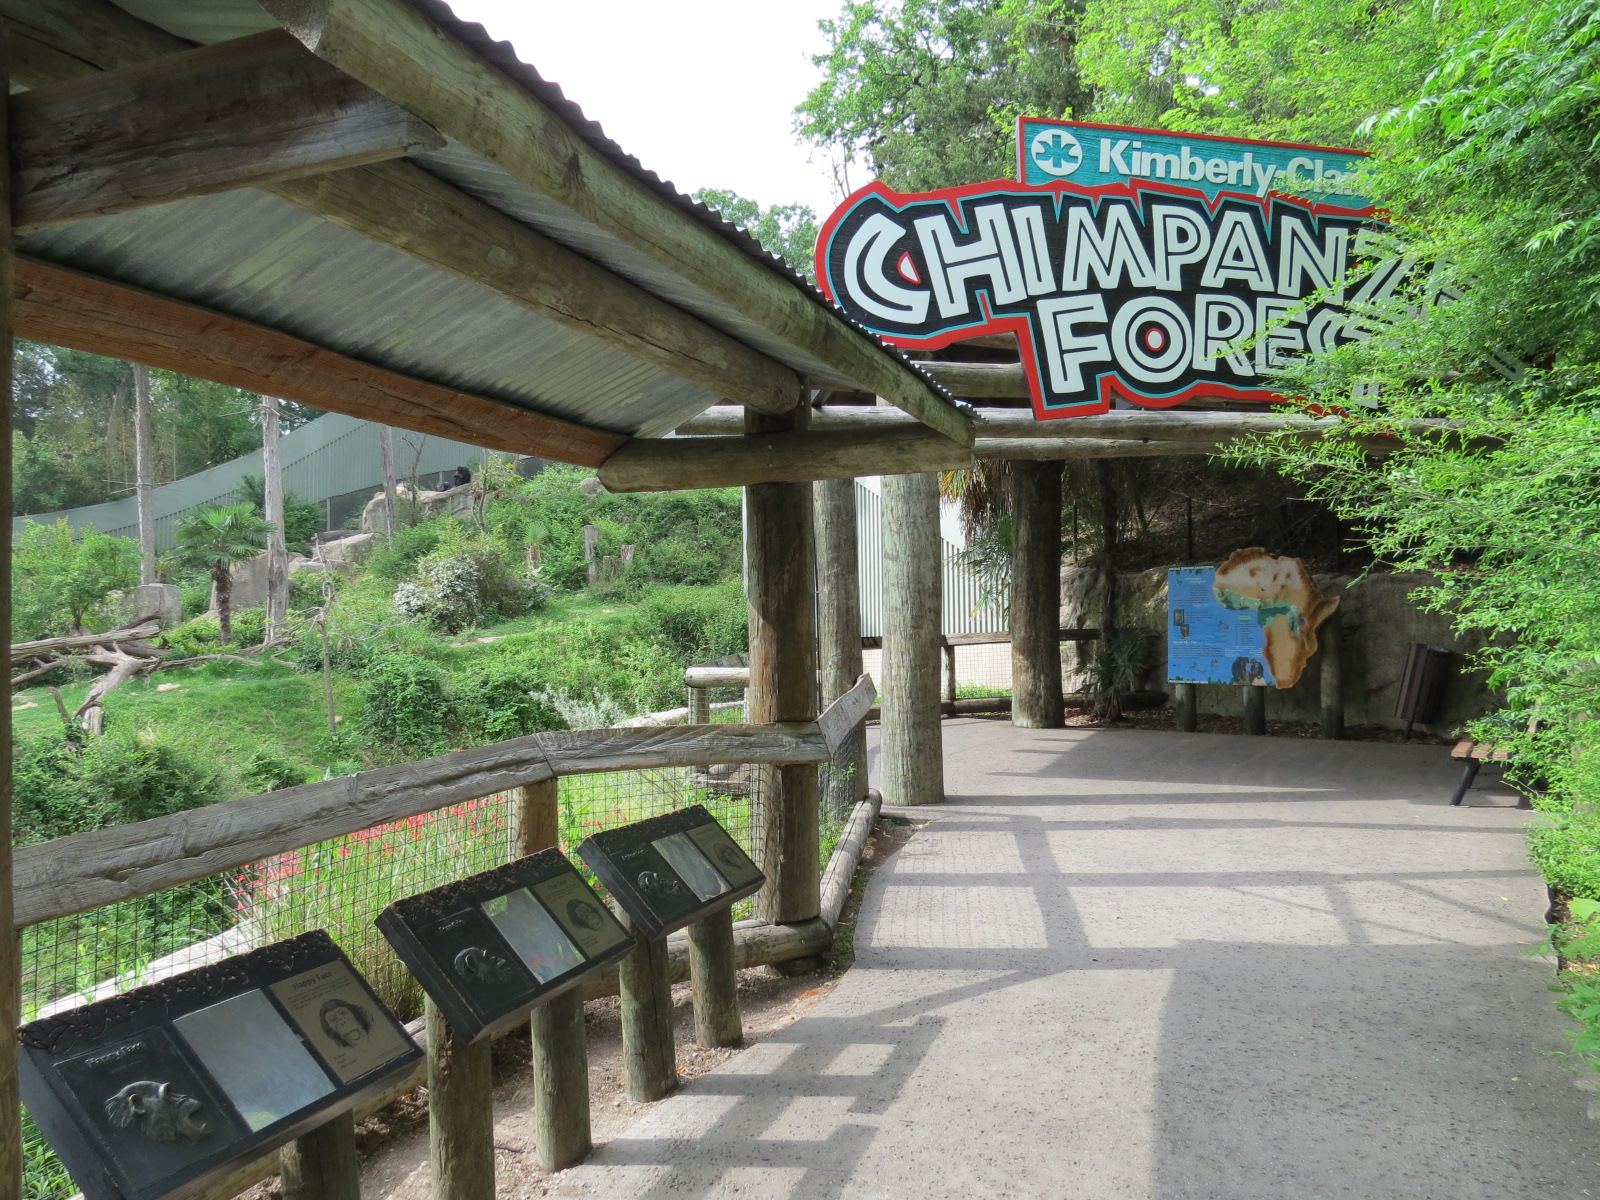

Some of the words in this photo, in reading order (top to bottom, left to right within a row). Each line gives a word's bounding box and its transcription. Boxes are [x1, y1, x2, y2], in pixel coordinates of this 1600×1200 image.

[1098, 137, 1378, 198] Kimberly-Clar
[845, 203, 1521, 382] CHIMPANZ
[1043, 293, 1388, 408] FORES
[291, 977, 316, 990] Happy
